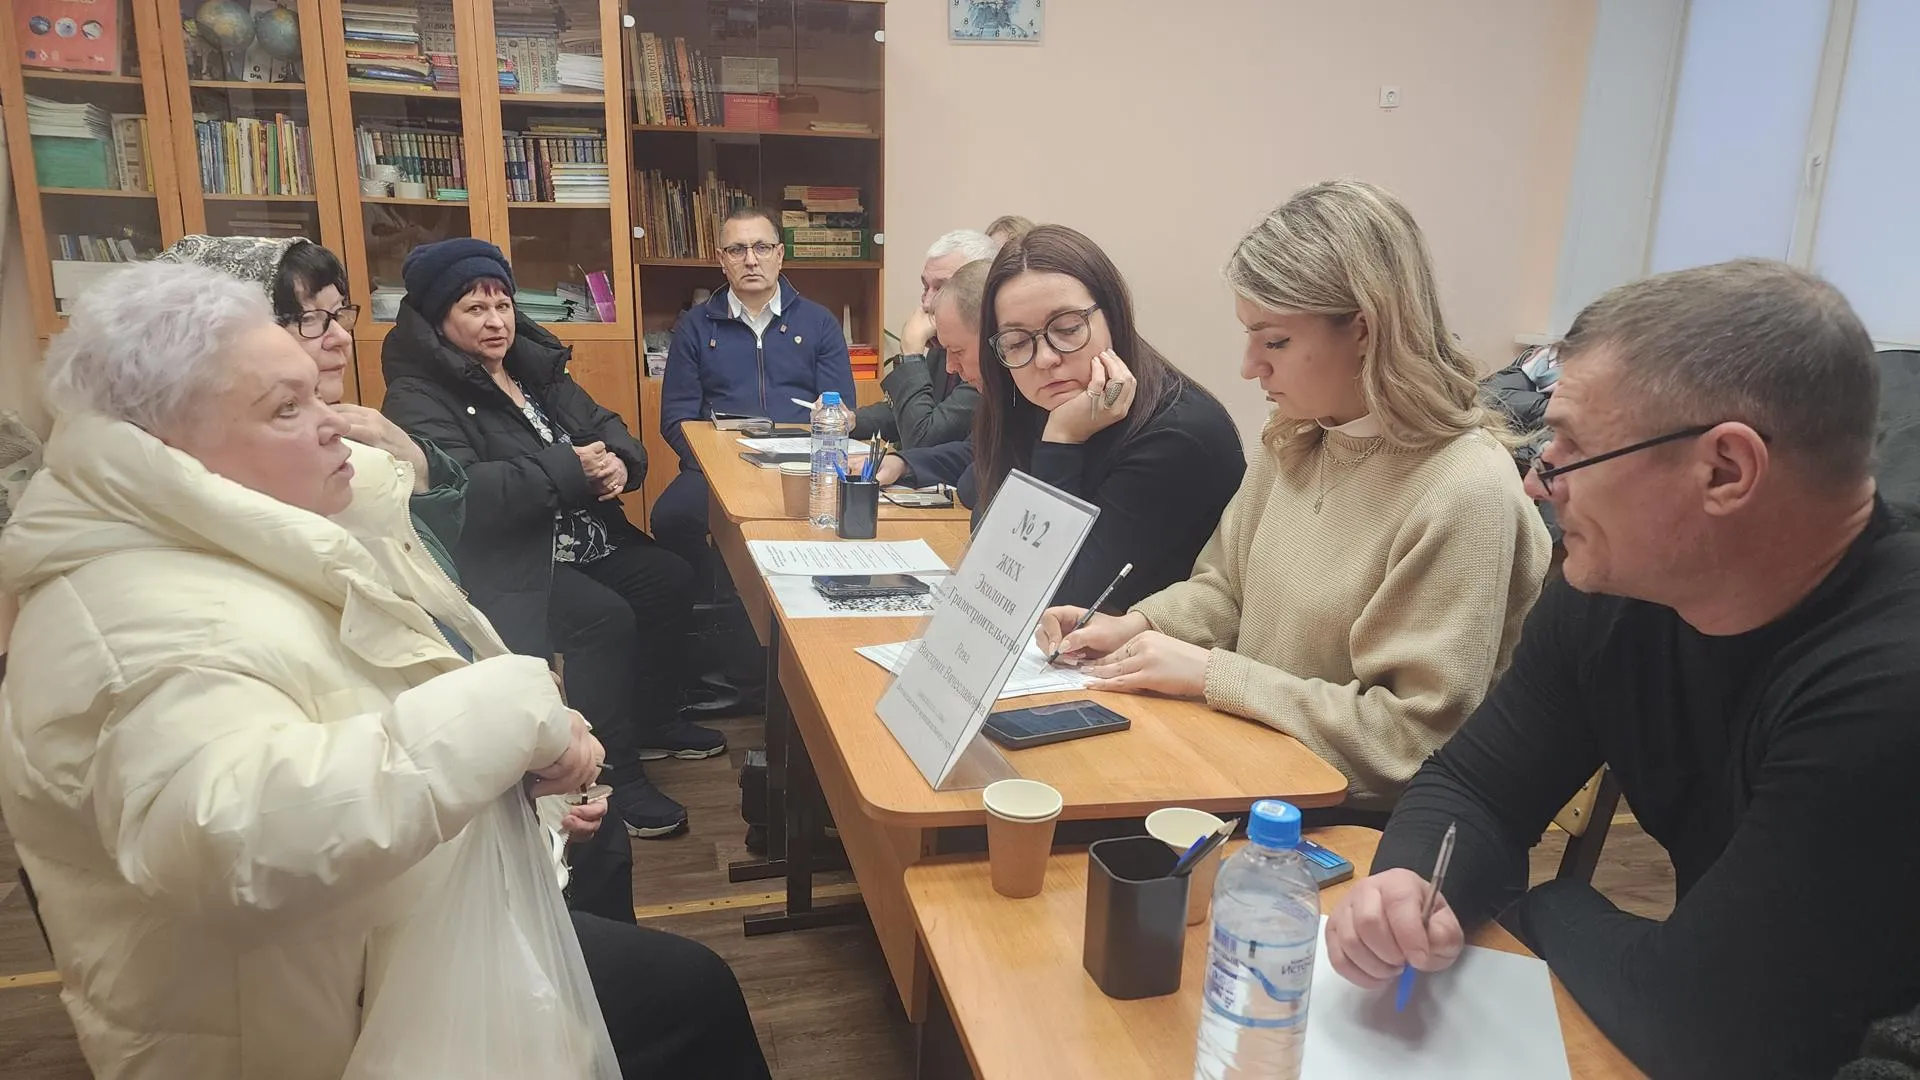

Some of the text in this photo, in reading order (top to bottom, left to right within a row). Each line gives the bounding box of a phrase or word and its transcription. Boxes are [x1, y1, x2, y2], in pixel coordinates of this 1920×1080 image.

[1011, 508, 1053, 549] № 2
[995, 552, 1026, 583] ЖКХ
[974, 573, 1017, 617] Экология
[947, 585, 1021, 656] Градостроительство
[953, 641, 972, 665] Рева
[943, 665, 987, 718] Вячеславовна
